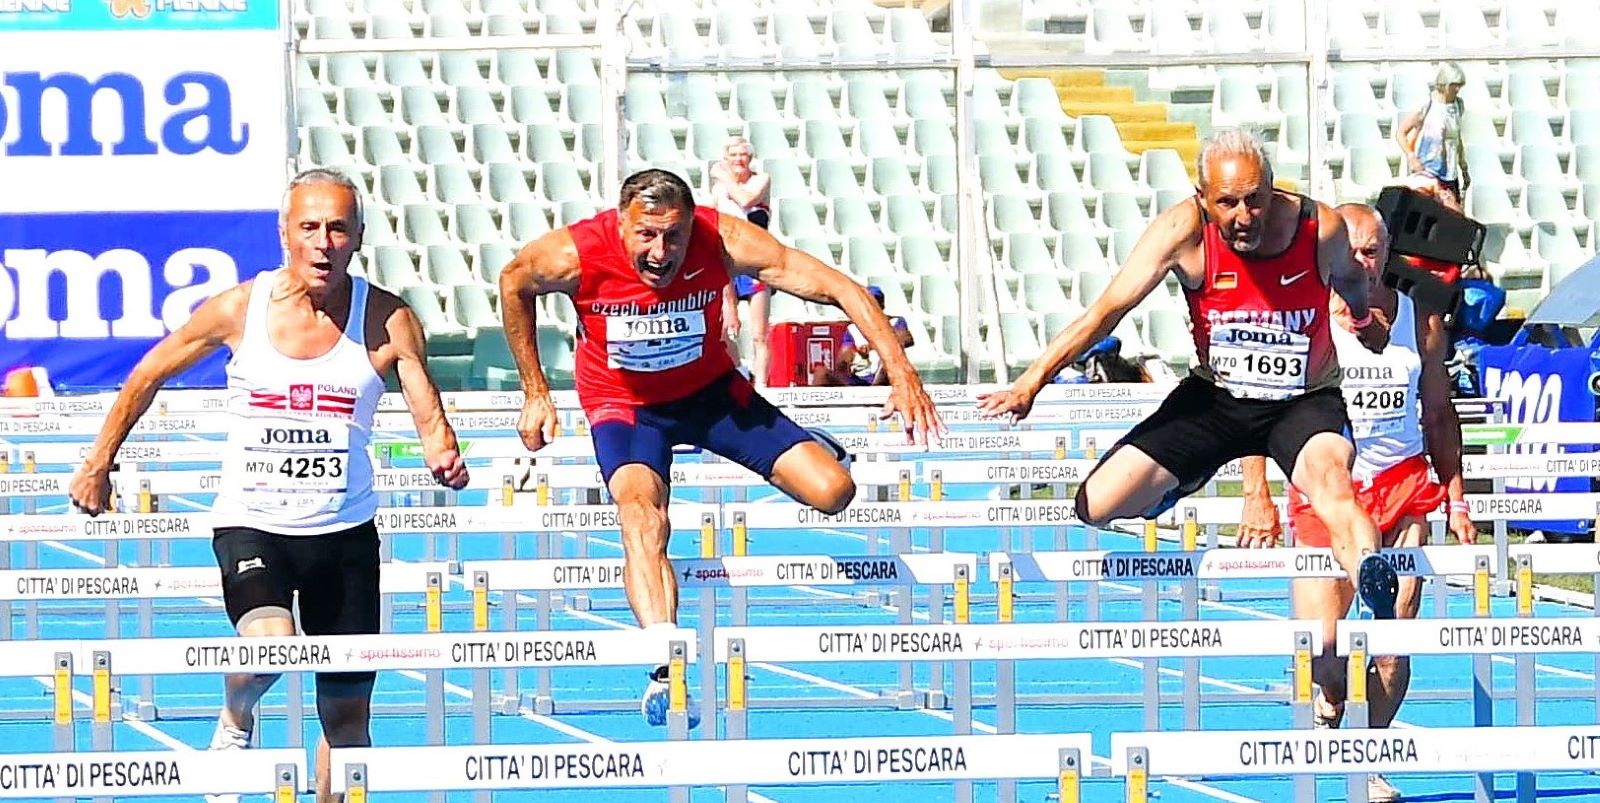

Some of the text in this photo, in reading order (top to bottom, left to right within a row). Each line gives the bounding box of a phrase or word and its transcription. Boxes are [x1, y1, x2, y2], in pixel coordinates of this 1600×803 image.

[0, 71, 249, 156] ma
[0, 248, 240, 338] ma
[1226, 328, 1294, 346] Joma
[1244, 354, 1302, 377] 1693
[317, 384, 357, 396] POLAND
[1352, 391, 1405, 409] 4208
[261, 428, 332, 444] Joma
[980, 437, 1021, 448] PESCARA
[246, 457, 342, 478] M70 4253
[988, 467, 1078, 479] CITTA' DI PESCARA
[1579, 460, 1589, 472] DI
[13, 480, 59, 491] PESCARA
[200, 476, 221, 488] CITT
[373, 474, 397, 486] ITTA'
[400, 474, 409, 486] DI
[988, 507, 1022, 521] CITTA'
[1025, 507, 1036, 520] DI
[1039, 506, 1076, 520] PESCA
[1477, 501, 1487, 513] DI
[1490, 500, 1542, 513] PESCARA
[391, 514, 401, 528] DI
[404, 513, 457, 528] PESCARA
[543, 514, 577, 527] CITTA'
[580, 513, 590, 526] DI
[849, 509, 901, 522] PESCARA
[85, 522, 120, 534] CITTA'
[124, 520, 134, 533] DI
[138, 518, 189, 533] PESCARA
[776, 563, 818, 580] CITTA'
[821, 563, 833, 579] DI
[837, 562, 898, 580] PESCARA
[1072, 559, 1113, 576] CITTA'
[1116, 558, 1129, 575] DI
[1132, 558, 1194, 575] PESCARA
[1295, 554, 1332, 571] CITTA
[553, 567, 595, 583] CITTA'
[599, 566, 611, 582] DI
[17, 577, 139, 594] CITTA' DI PESCARA
[819, 633, 868, 653] CITTA'
[872, 633, 887, 652] DI
[891, 632, 963, 652] PESCARA
[1079, 629, 1127, 649] CITTA'
[1132, 629, 1146, 648] DI
[1150, 628, 1222, 648] PESCARA
[1439, 625, 1582, 646] CITTA' DI PESCARA
[186, 648, 235, 666] CITTA'
[239, 647, 253, 665] DI
[258, 645, 331, 665] PESCARA
[452, 643, 499, 662] CITTA'
[505, 643, 519, 661] DI
[524, 641, 596, 661] PESCARA
[1240, 735, 1600, 765] CITTA' DI PESCARA CIT
[466, 747, 967, 780] CITTA' DI PESCARA CITTA' DI PESCARA
[0, 761, 181, 789] CITTA' DI PESCARA
